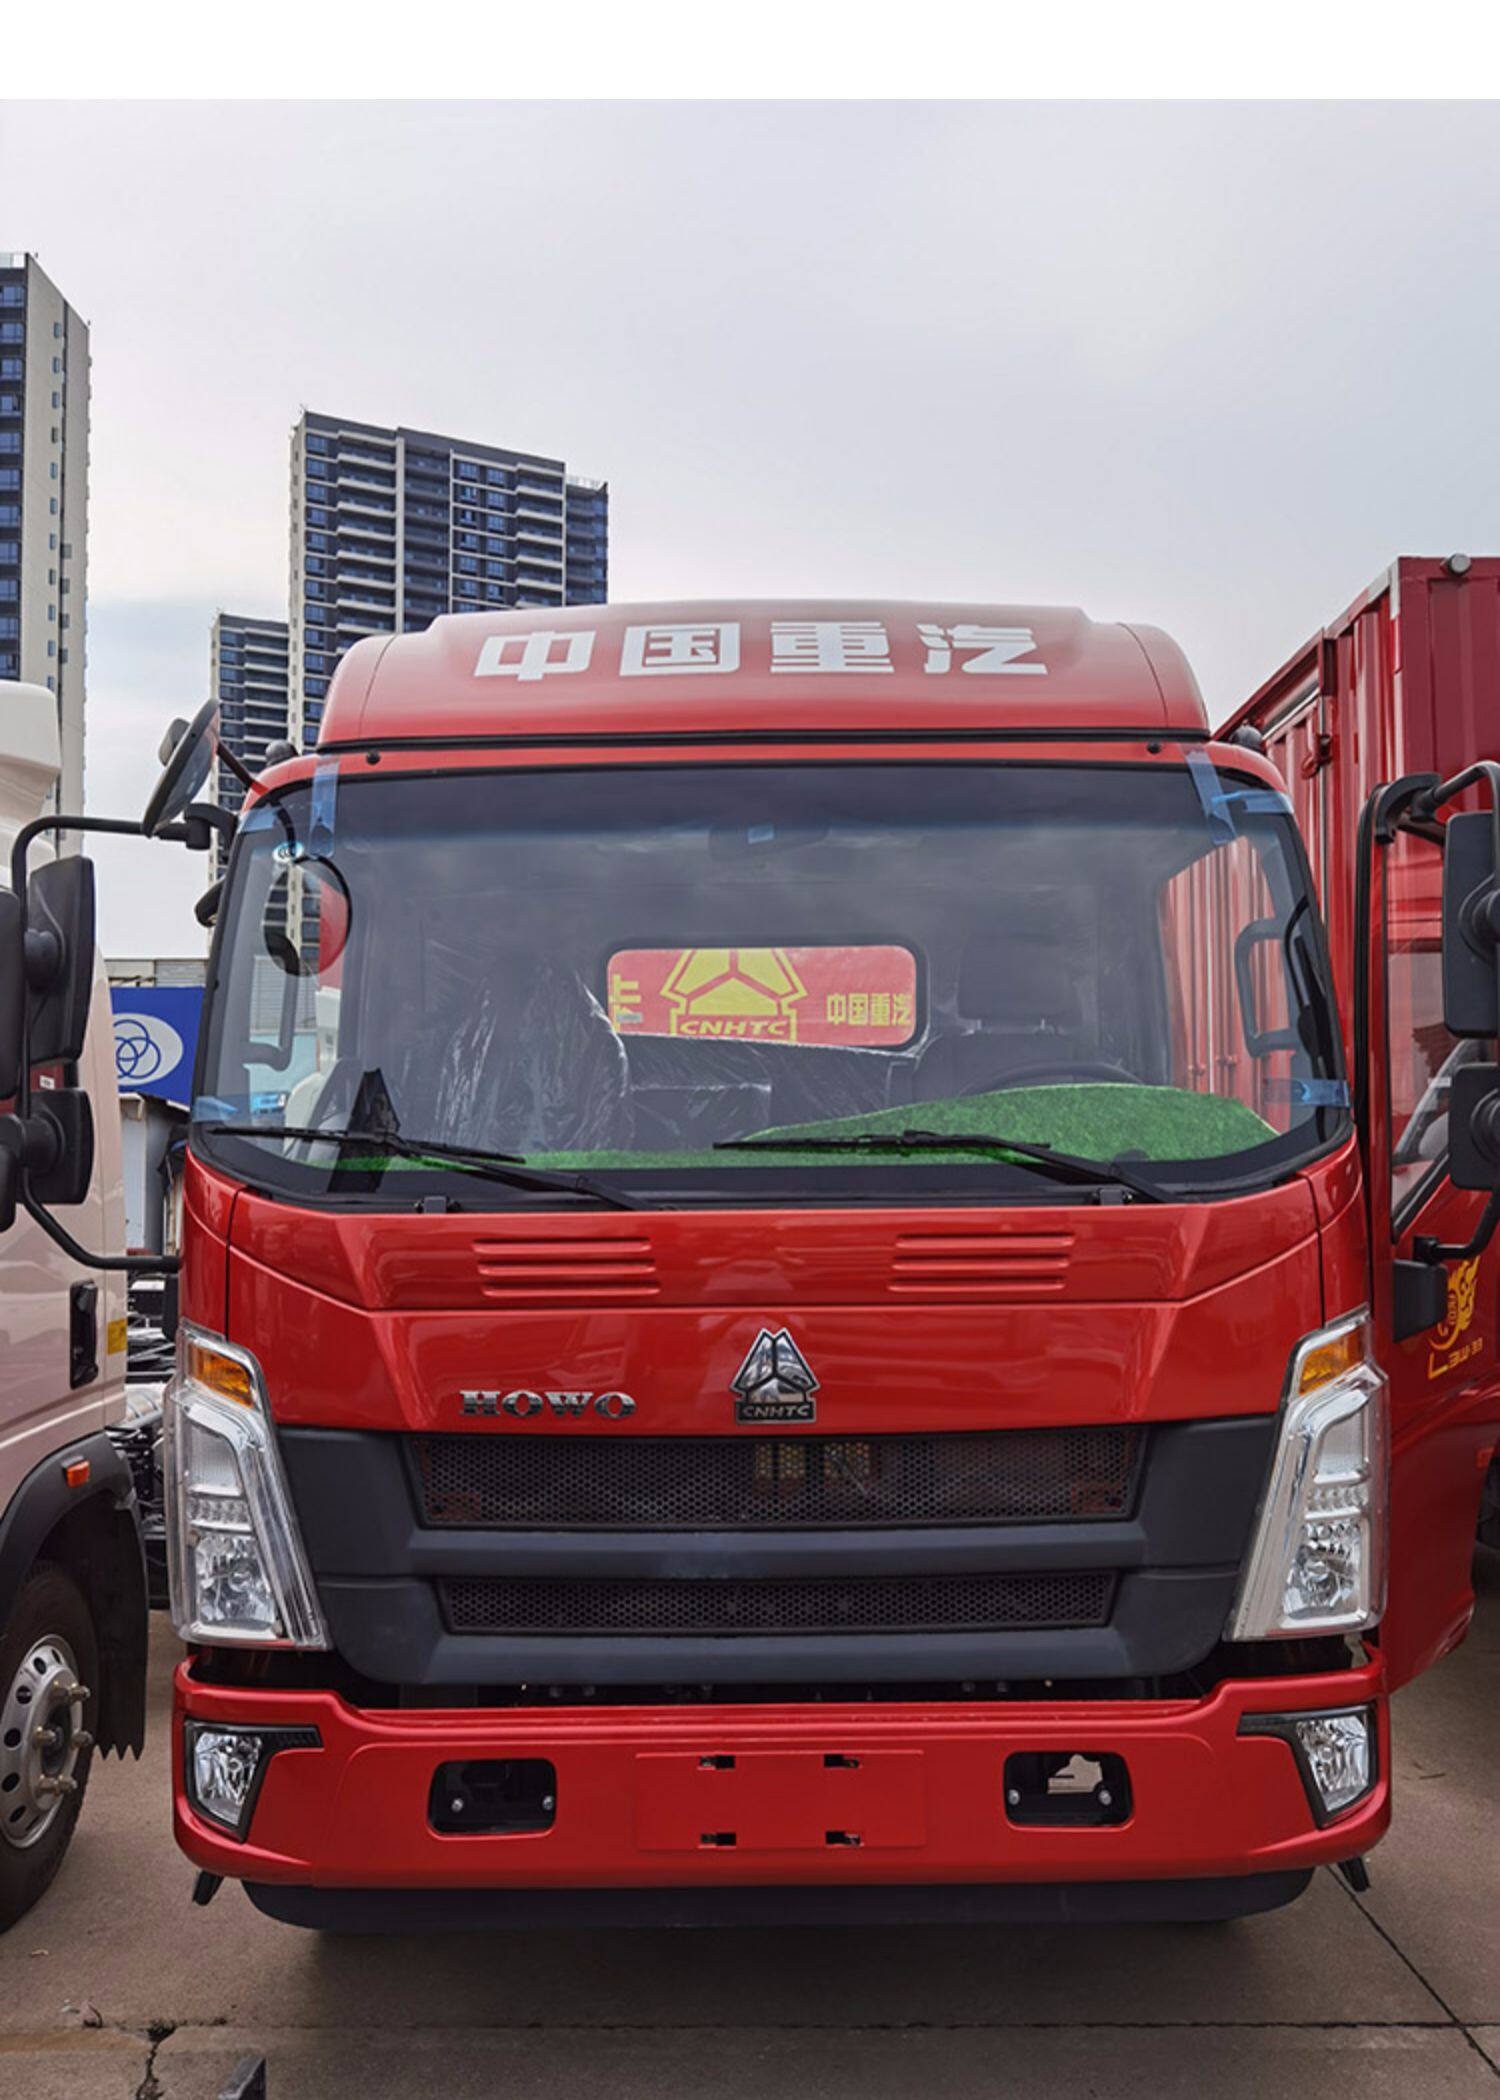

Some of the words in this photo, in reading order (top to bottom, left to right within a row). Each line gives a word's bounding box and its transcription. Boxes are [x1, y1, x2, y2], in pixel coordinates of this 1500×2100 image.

[473, 620, 1048, 682] 中国重汽
[679, 1020, 787, 1036] CNHTC
[458, 1389, 637, 1419] HOWO
[742, 1404, 811, 1418] CNHTC
